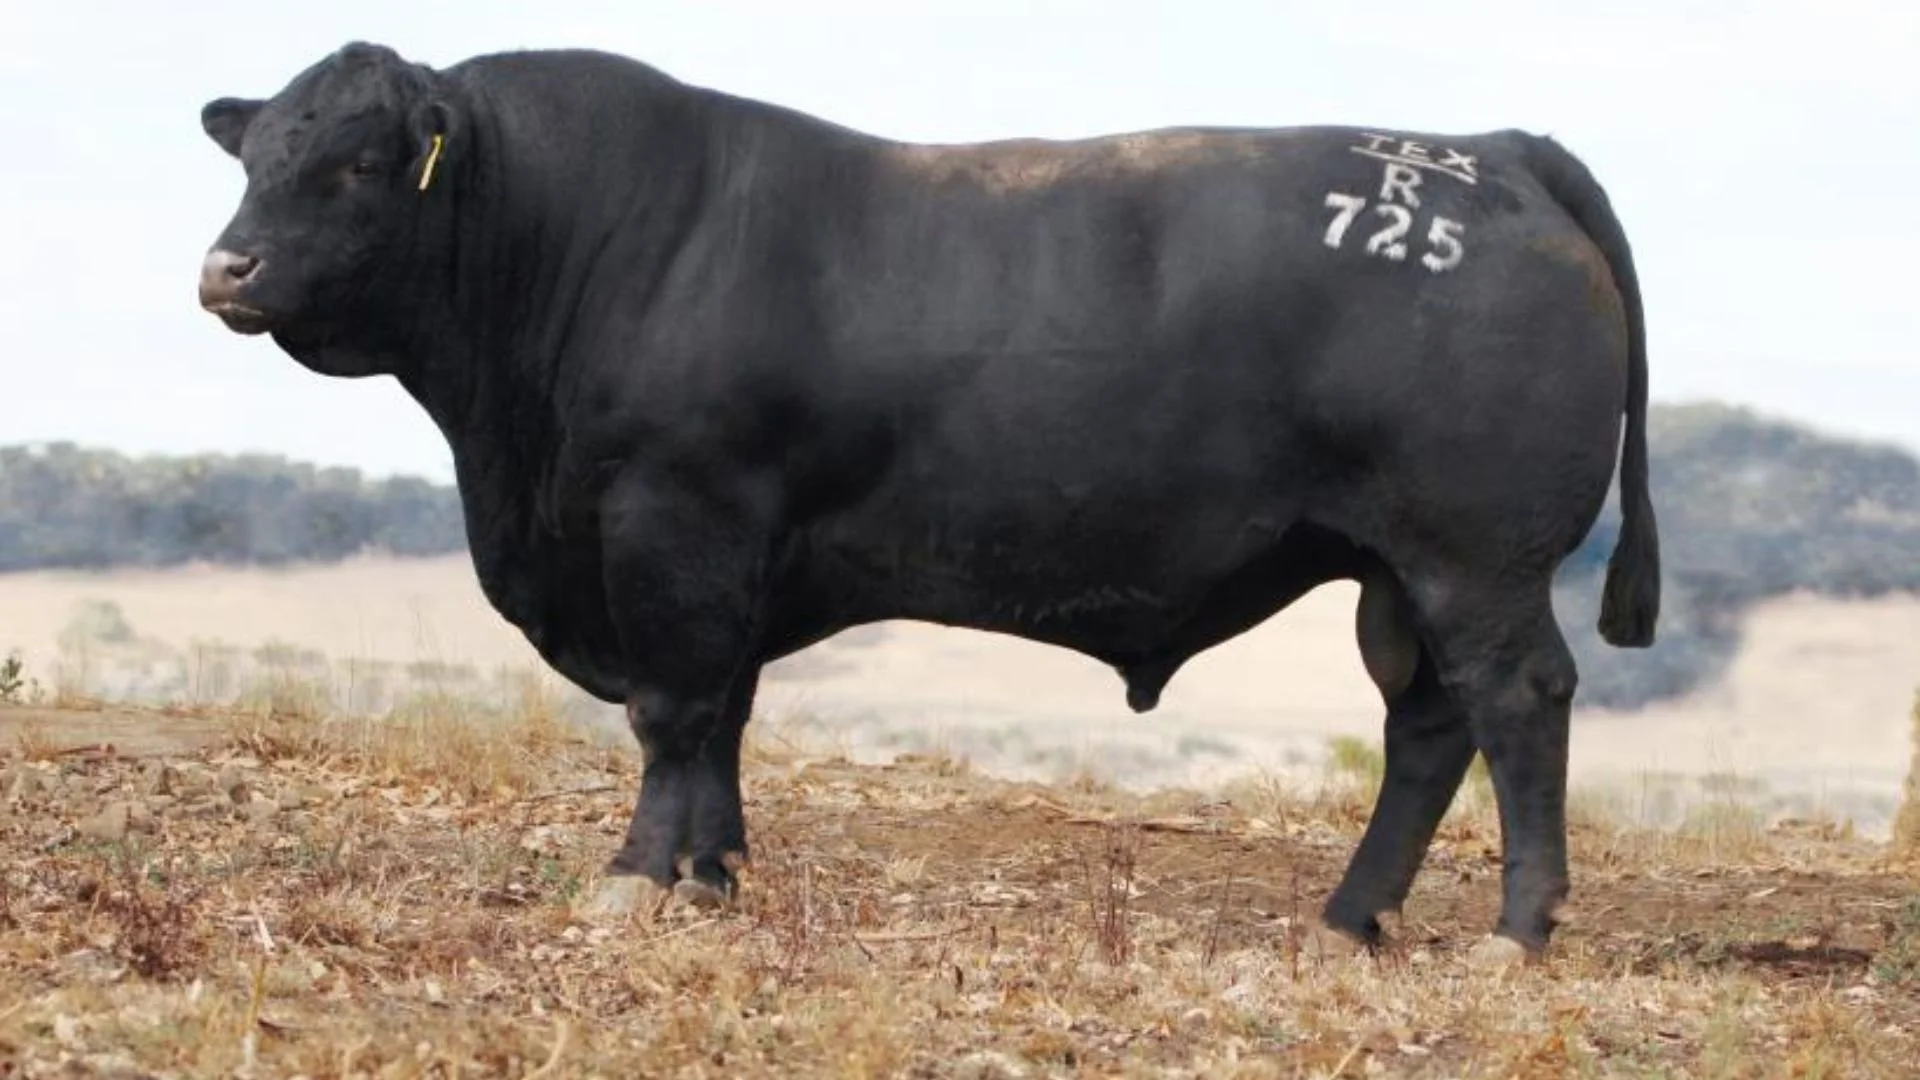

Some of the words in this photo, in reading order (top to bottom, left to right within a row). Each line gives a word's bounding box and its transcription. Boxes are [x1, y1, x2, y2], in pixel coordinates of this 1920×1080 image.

[1360, 132, 1479, 177] TEX
[1379, 163, 1423, 209] R
[1324, 192, 1465, 272] 725
